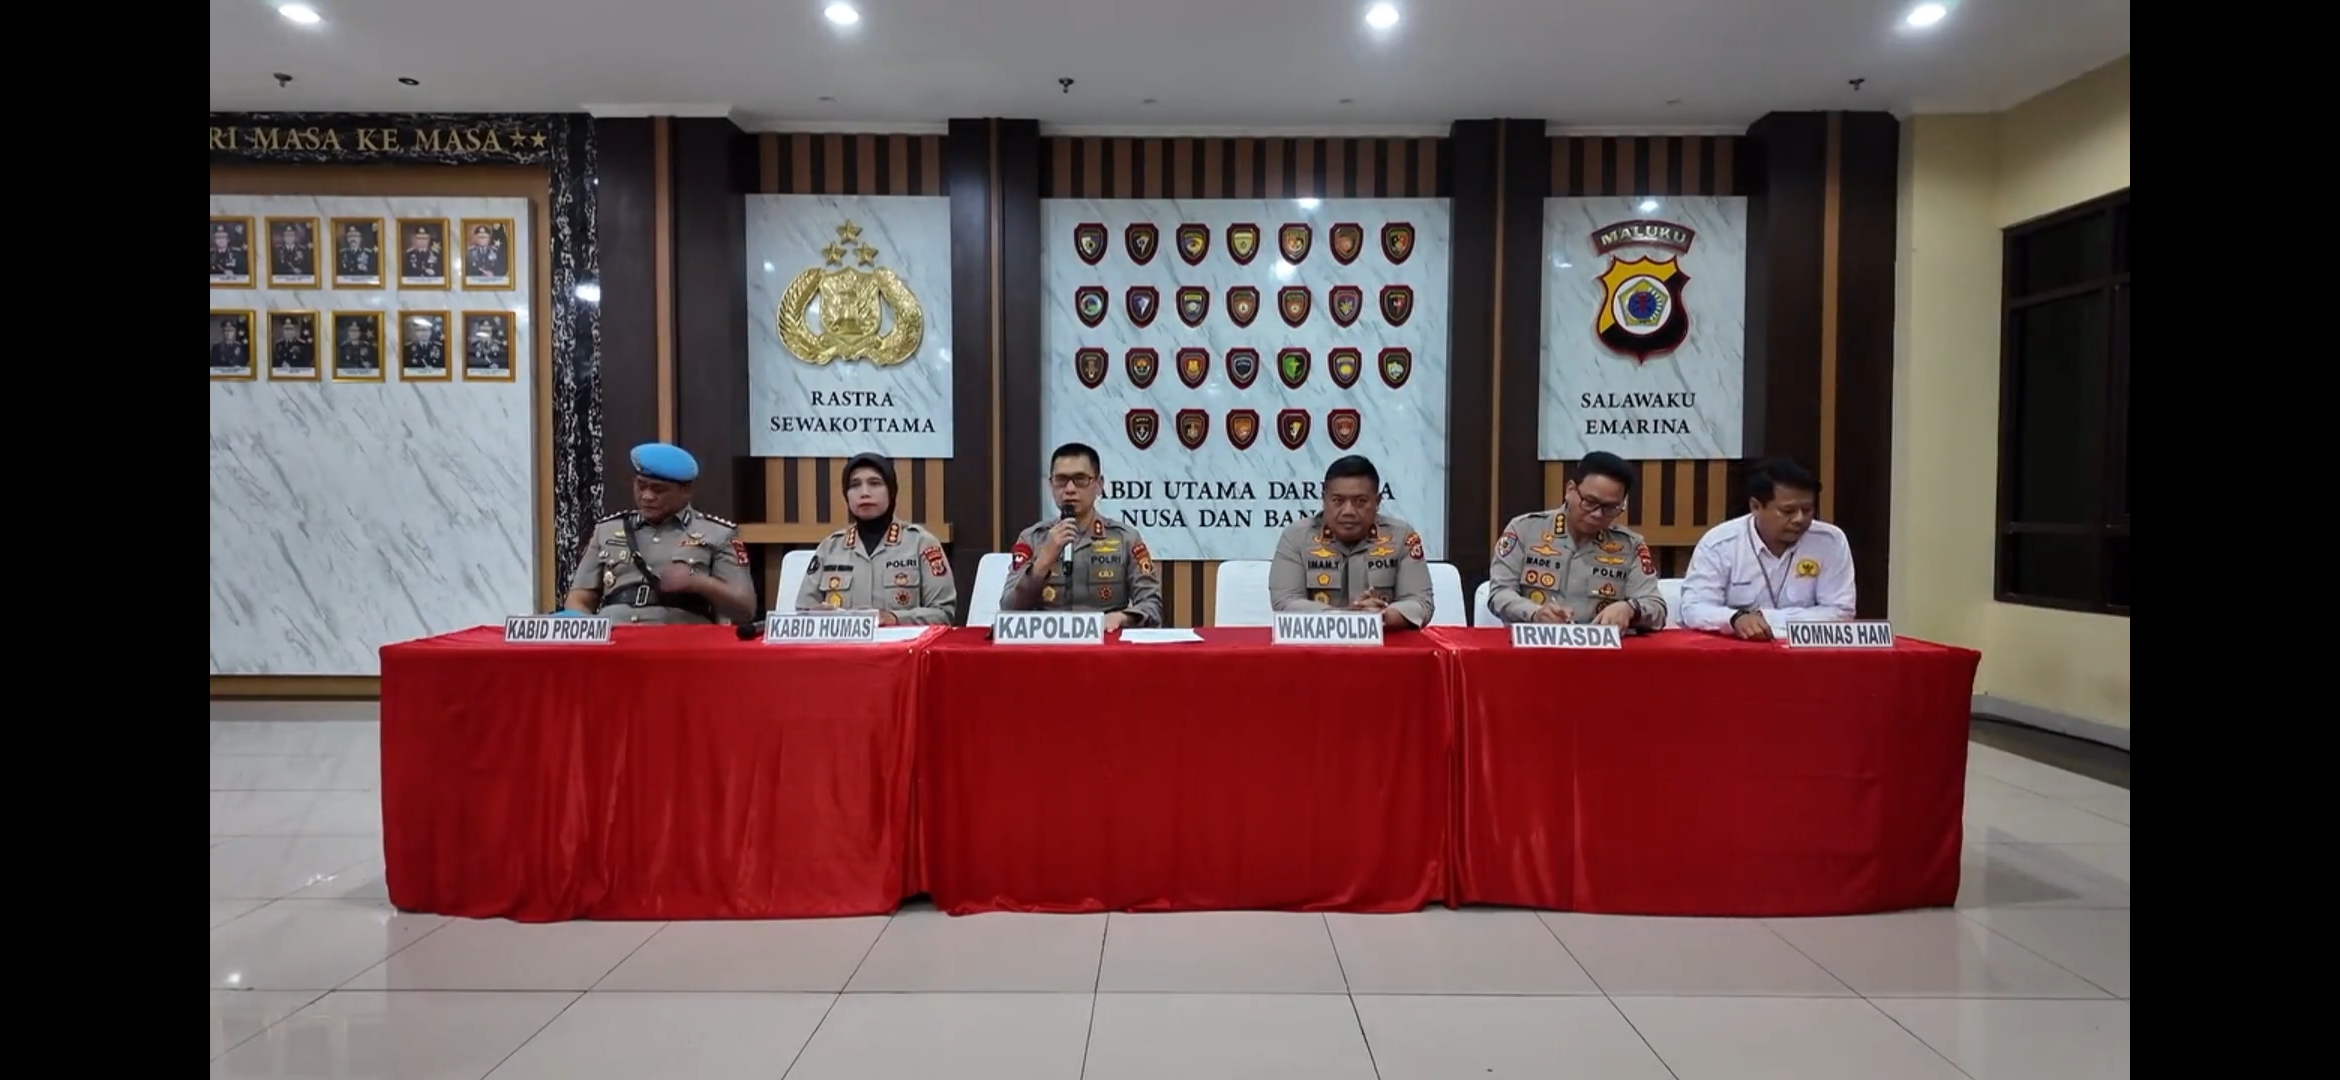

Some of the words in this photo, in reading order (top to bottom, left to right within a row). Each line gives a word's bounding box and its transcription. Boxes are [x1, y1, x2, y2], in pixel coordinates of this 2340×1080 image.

[252, 126, 342, 151] MASA
[356, 127, 400, 151] KE
[414, 127, 503, 151] MASA
[1601, 225, 1687, 246] MALUKU
[811, 391, 895, 408] RASTRA
[1580, 392, 1697, 409] SALAWAKU
[770, 416, 936, 433] SEWAKOTTAMA
[1585, 419, 1691, 435] EMARINA
[1163, 481, 1256, 500] UTAMA
[1120, 509, 1188, 528] NUSA
[1198, 509, 1252, 528] DAN
[886, 559, 917, 569] POLRI
[1091, 555, 1122, 564] POLRI
[507, 619, 549, 640] KABID
[552, 619, 607, 640] PROPAM
[770, 618, 815, 638] KABID
[819, 618, 871, 638] HUMAS
[999, 616, 1099, 639] KAPOLDA
[1278, 616, 1379, 640] WAKAPOLDA
[1515, 625, 1620, 648] IRWASDA
[1790, 624, 1853, 645] KOMNAS
[1857, 624, 1891, 645] HAM
